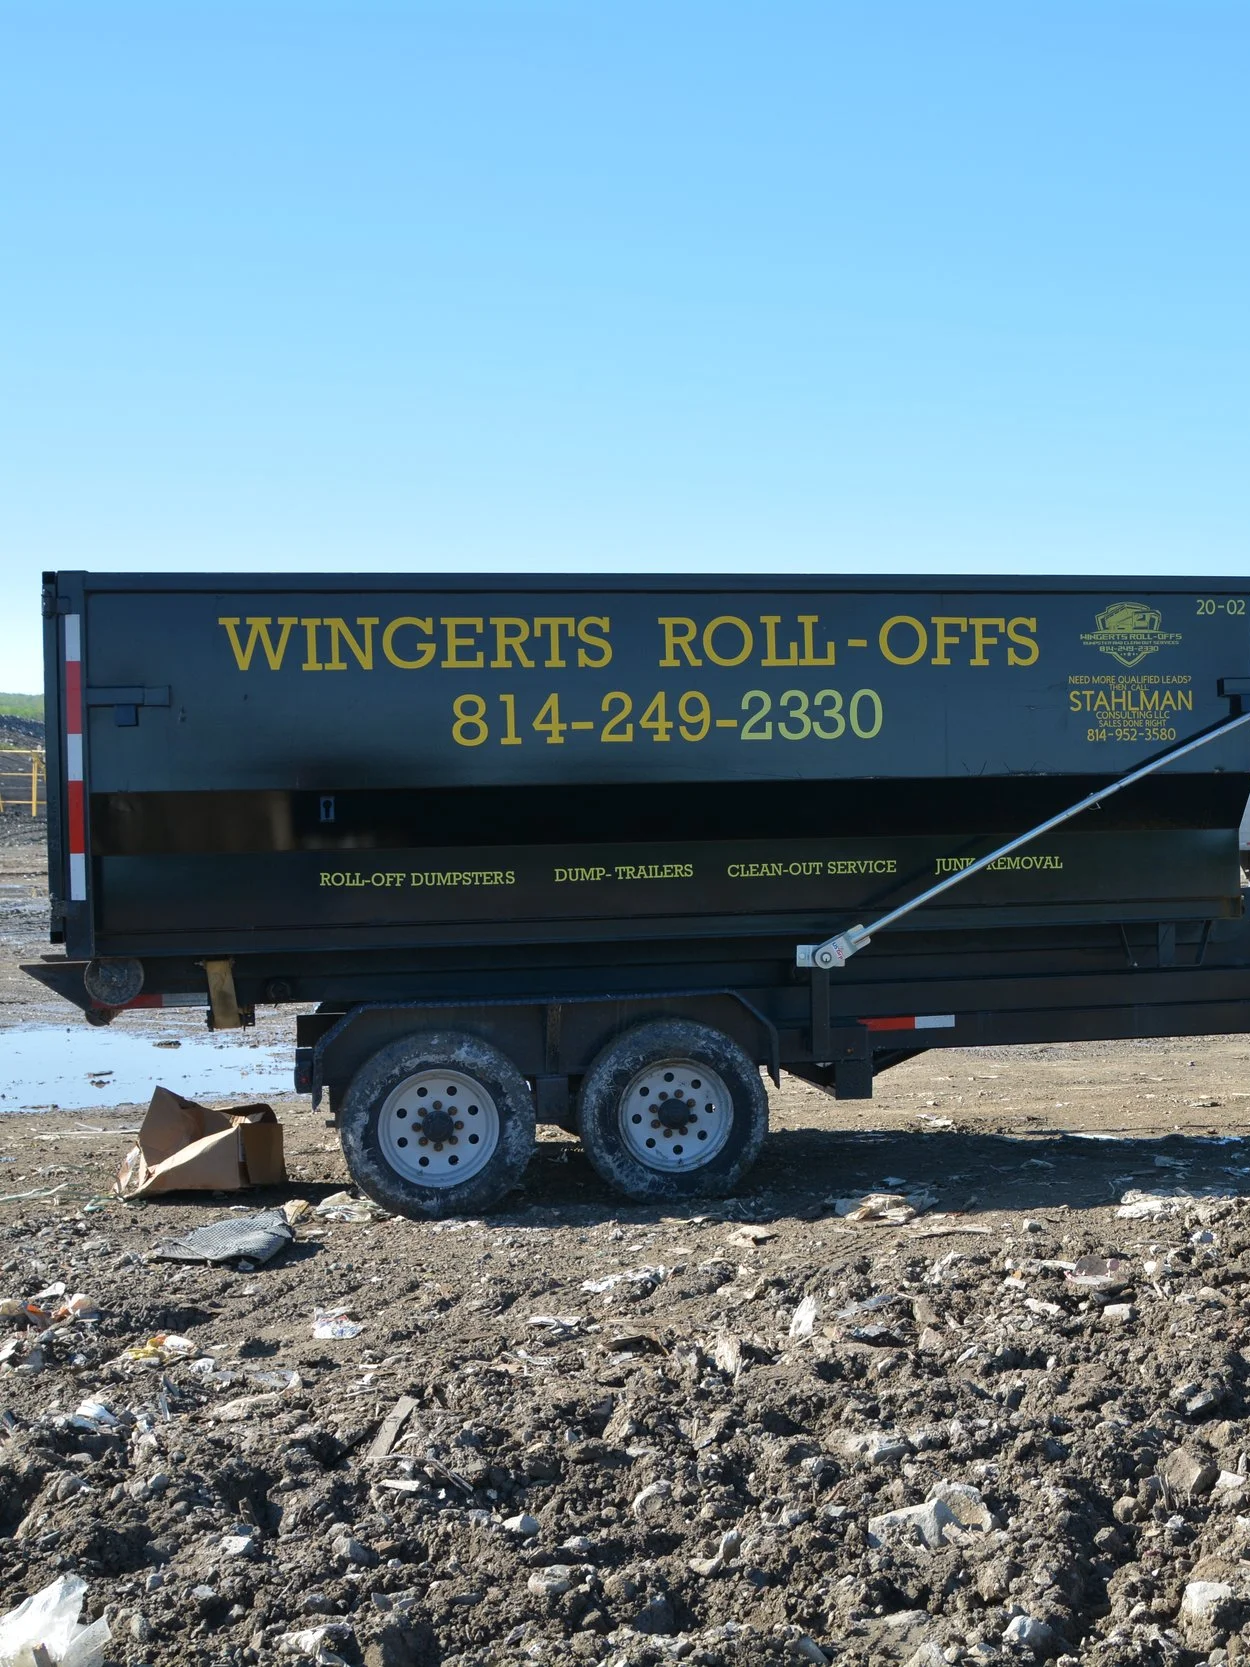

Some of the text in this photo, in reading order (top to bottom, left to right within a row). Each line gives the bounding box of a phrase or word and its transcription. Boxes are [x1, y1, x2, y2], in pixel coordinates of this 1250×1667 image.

[1196, 599, 1246, 616] 20-02
[218, 615, 1040, 671] WINGERTS ROLL-OFFS
[1079, 633, 1183, 641] WINGERTS ROLL-OFFS
[1068, 675, 1192, 685] NEED MORE QUALIFIED LEADS?
[1069, 690, 1193, 712] STAHLMAN
[452, 688, 883, 747] 814-249-2330
[1095, 710, 1170, 720] CONSULTING LLC
[1098, 719, 1167, 728] SALES DONE RIGHT
[1086, 728, 1176, 741] 814-952-3580
[614, 863, 694, 880] TRAILERS
[727, 859, 897, 878] CLEAN-OUT SERVICE
[319, 870, 516, 887] ROLL-OFF DUMPSTERS
